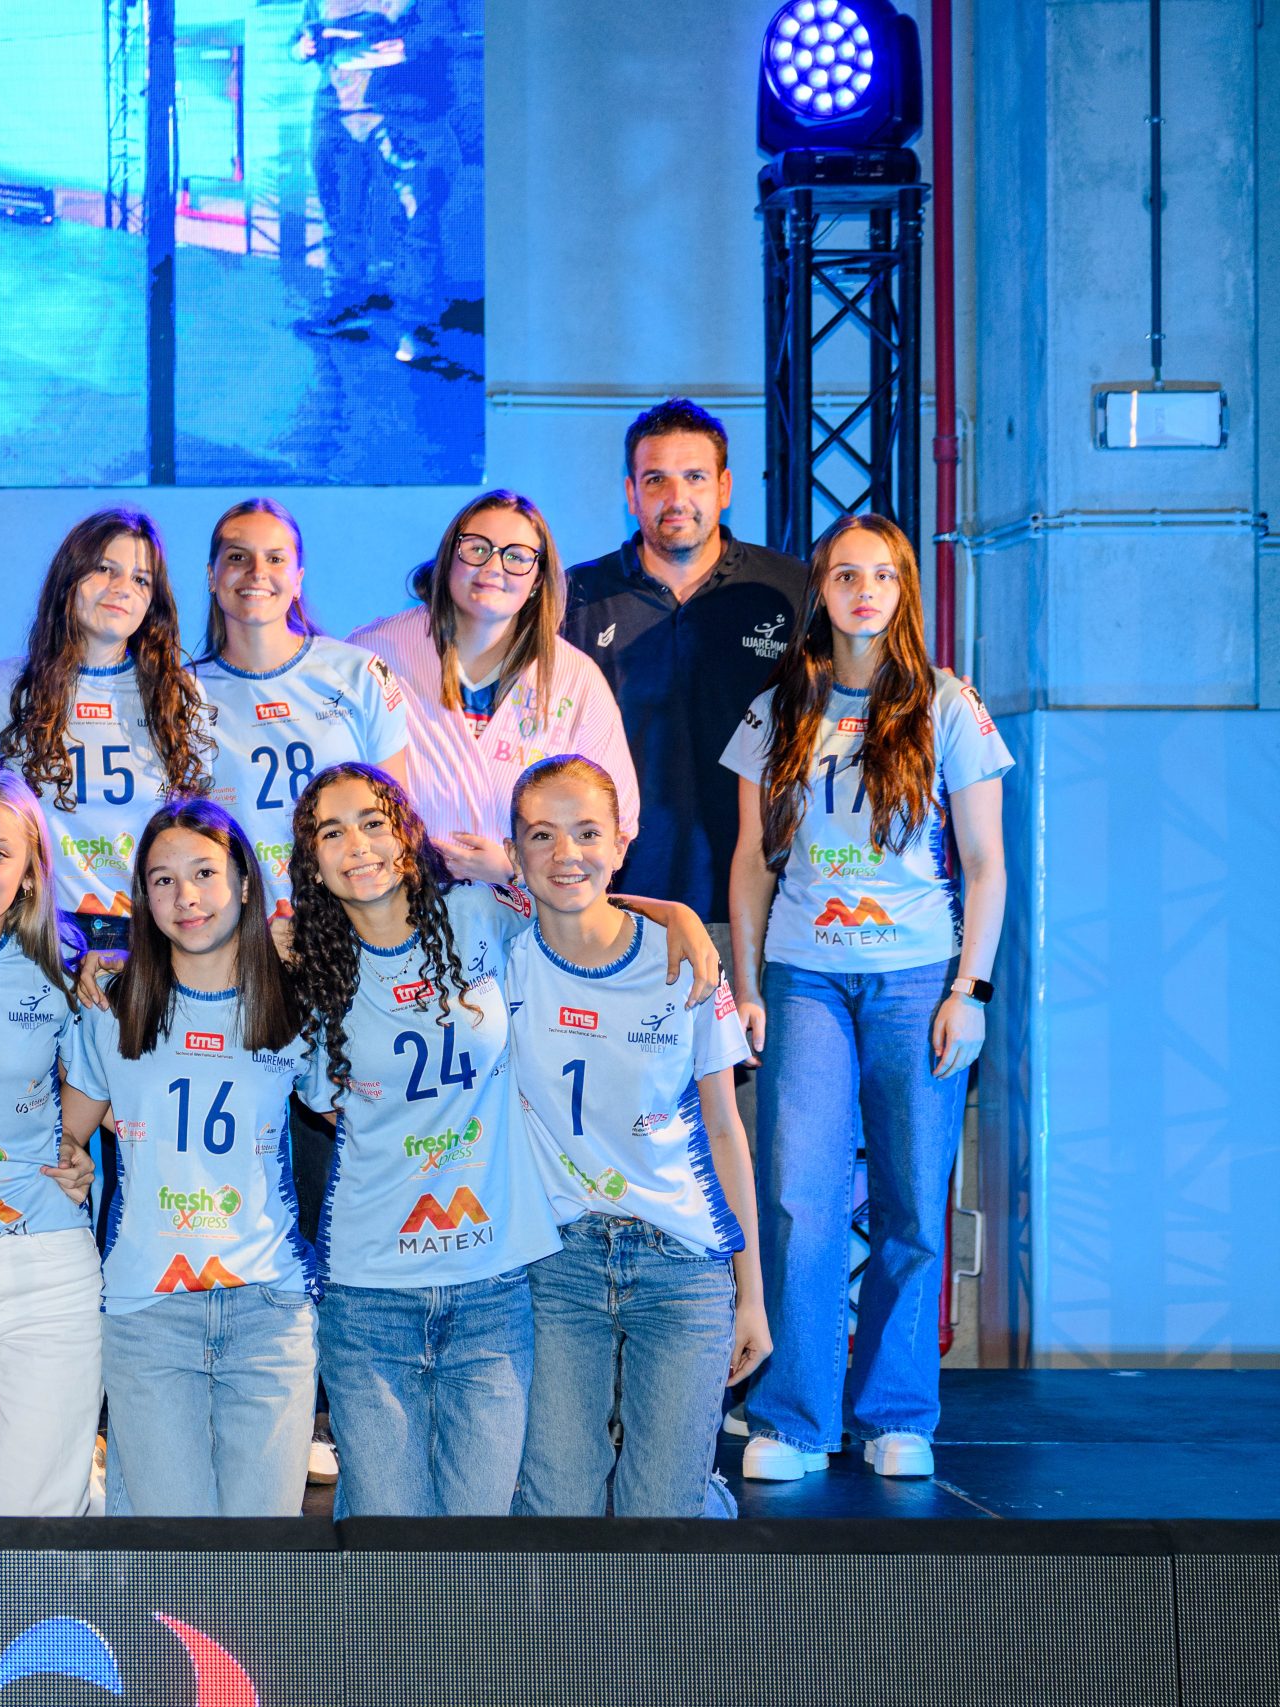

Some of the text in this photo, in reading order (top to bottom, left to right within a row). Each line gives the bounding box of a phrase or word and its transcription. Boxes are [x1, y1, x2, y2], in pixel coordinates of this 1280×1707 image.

[755, 648, 778, 660] VOLLEY
[79, 705, 109, 717] tms
[258, 704, 286, 718] tms
[841, 721, 868, 731] tms
[67, 745, 135, 805] 15
[251, 741, 315, 810] 28
[819, 754, 867, 814] 17
[61, 835, 113, 856] fresh
[255, 841, 293, 862] fres
[810, 844, 862, 865] fresh
[823, 862, 877, 878] eXpress
[815, 929, 897, 946] MATEXI
[8, 1011, 54, 1023] WAREMME
[563, 1009, 595, 1028] tms
[188, 1034, 221, 1049] tms
[628, 1031, 679, 1046] WAREMME
[640, 1044, 666, 1054] VOLLEY
[252, 1051, 295, 1069] WAREMME
[264, 1064, 286, 1073] VOLLEY
[394, 1022, 477, 1101] 24
[562, 1059, 586, 1136] 1
[168, 1077, 236, 1155] 16
[633, 1112, 669, 1128] Adeps
[404, 1128, 460, 1157] fresh
[159, 1186, 214, 1212] fresh
[172, 1209, 228, 1231] eXpress
[400, 1226, 494, 1255] MATEXI
